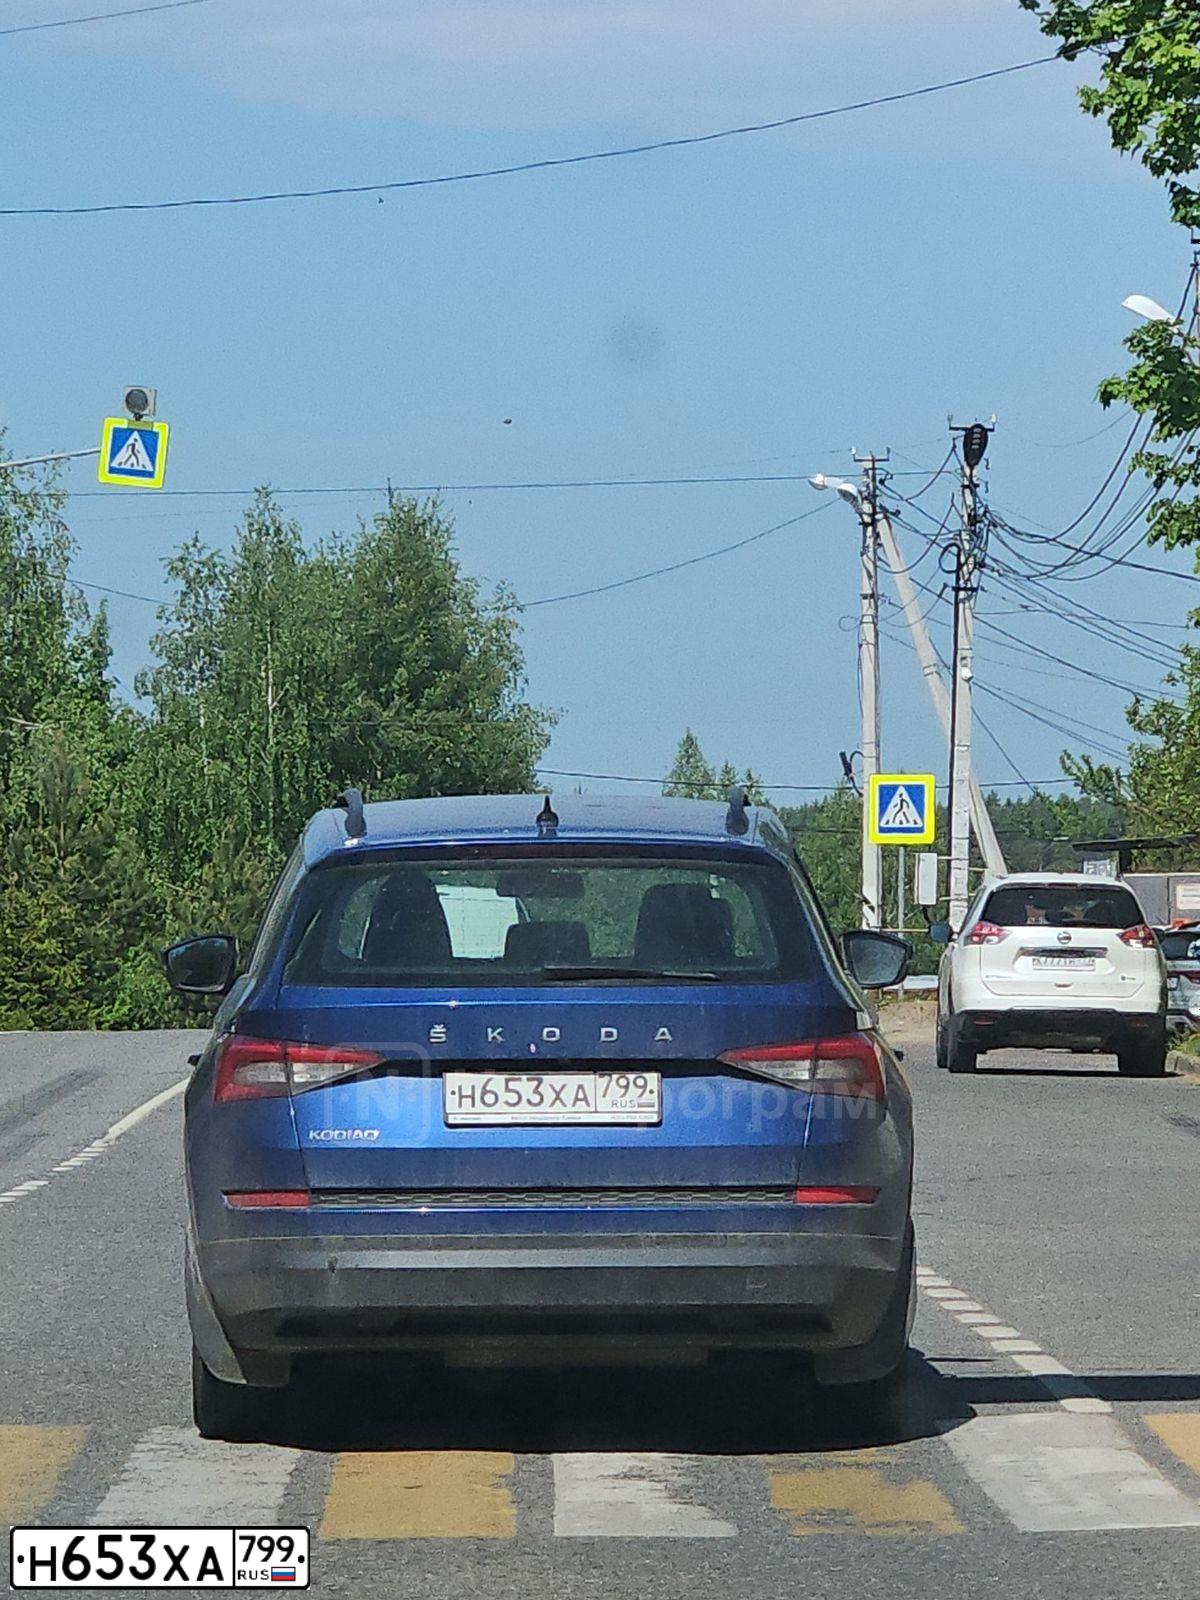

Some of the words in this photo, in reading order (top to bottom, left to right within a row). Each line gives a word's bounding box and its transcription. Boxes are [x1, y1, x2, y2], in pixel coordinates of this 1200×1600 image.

[430, 1024, 672, 1043] ŠKODA
[458, 1077, 591, 1109] Н653ХА
[599, 1074, 648, 1098] 799
[611, 1099, 636, 1109] RUS
[309, 1129, 381, 1141] KODIAQ
